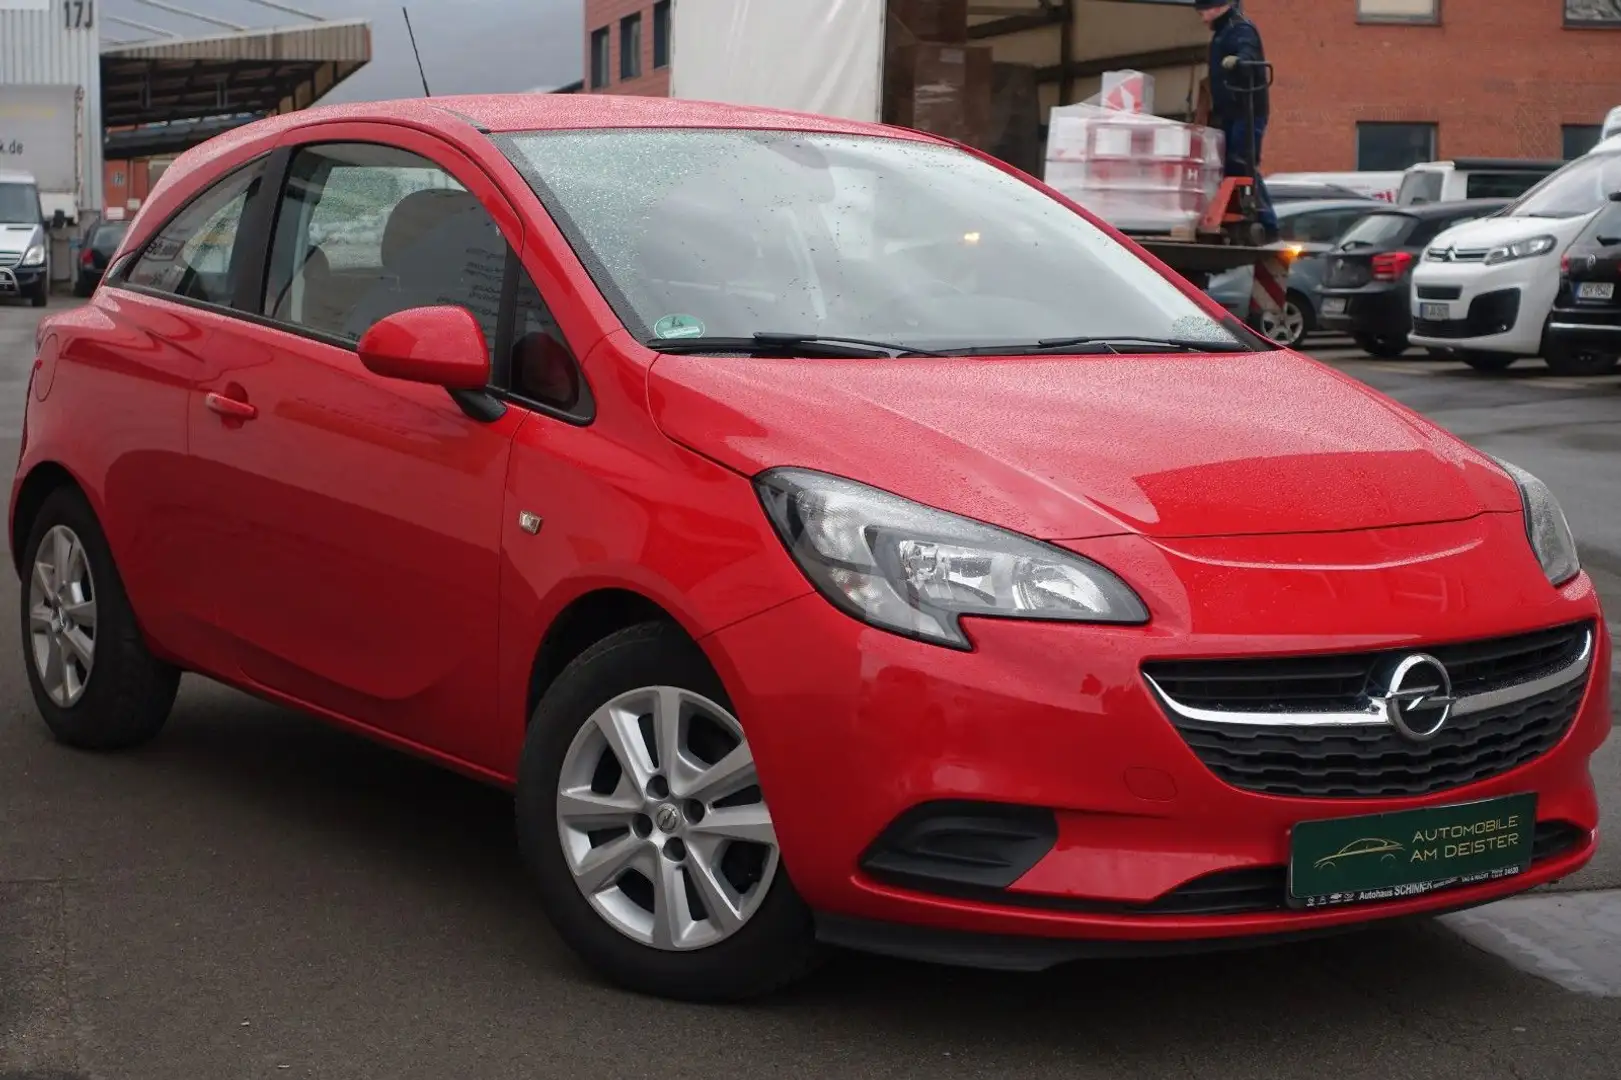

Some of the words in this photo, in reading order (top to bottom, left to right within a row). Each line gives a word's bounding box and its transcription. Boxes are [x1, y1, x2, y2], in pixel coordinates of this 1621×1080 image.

[63, 0, 93, 28] 17J
[1411, 815, 1519, 843] AUTOMOBILE
[1410, 848, 1438, 863] AM
[1444, 832, 1520, 858] DEISTER
[1358, 888, 1394, 901] Autohaus
